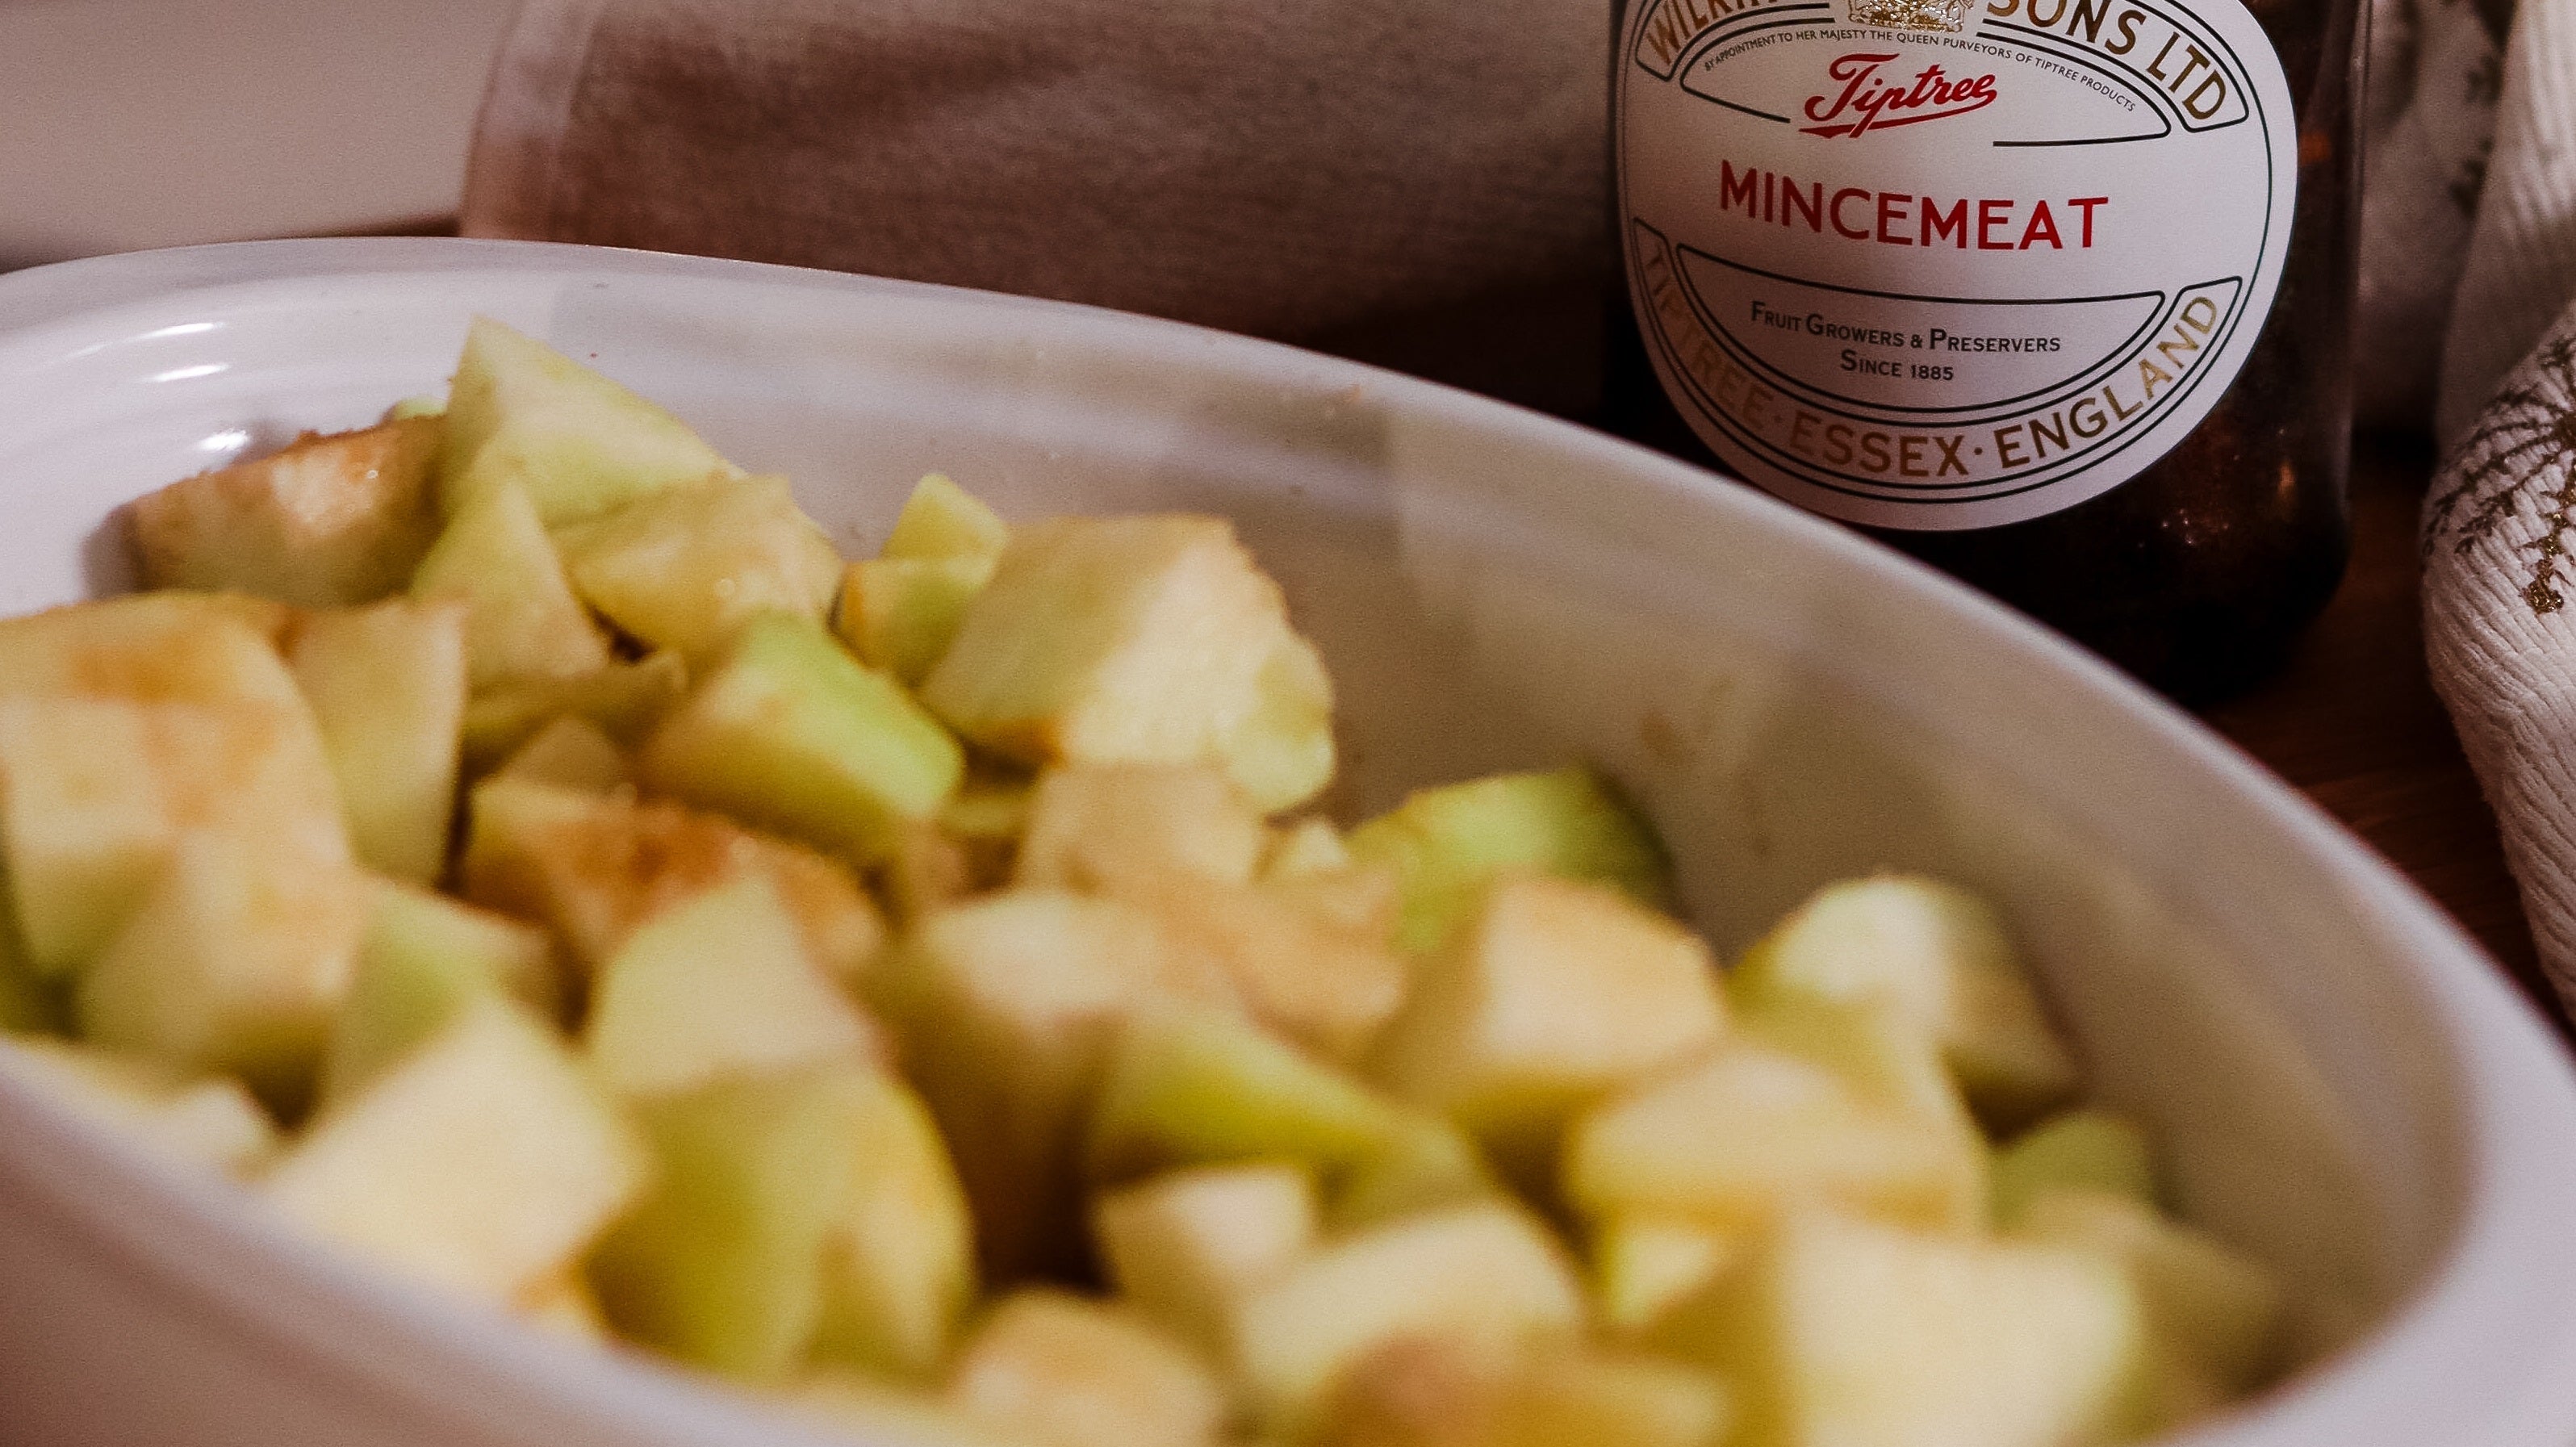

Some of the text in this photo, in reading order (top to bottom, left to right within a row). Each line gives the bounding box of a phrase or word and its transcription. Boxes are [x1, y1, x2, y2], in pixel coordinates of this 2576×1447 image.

[1646, 0, 1779, 65] WIL
[2146, 31, 2227, 120] LTD
[1704, 29, 2136, 113] BY APPOINTMENT TO HER MAJESTY THE QUEEN PURVEYORS OF TIPTREE PRODUCTS
[1799, 53, 1997, 138] Tiptree
[1719, 159, 2109, 250] MINCEMEAT
[1910, 334, 1923, 349] &
[1910, 364, 1954, 381] 1885
[1788, 410, 1968, 477] ESSEX
[1993, 295, 2218, 469] ENGLAND
